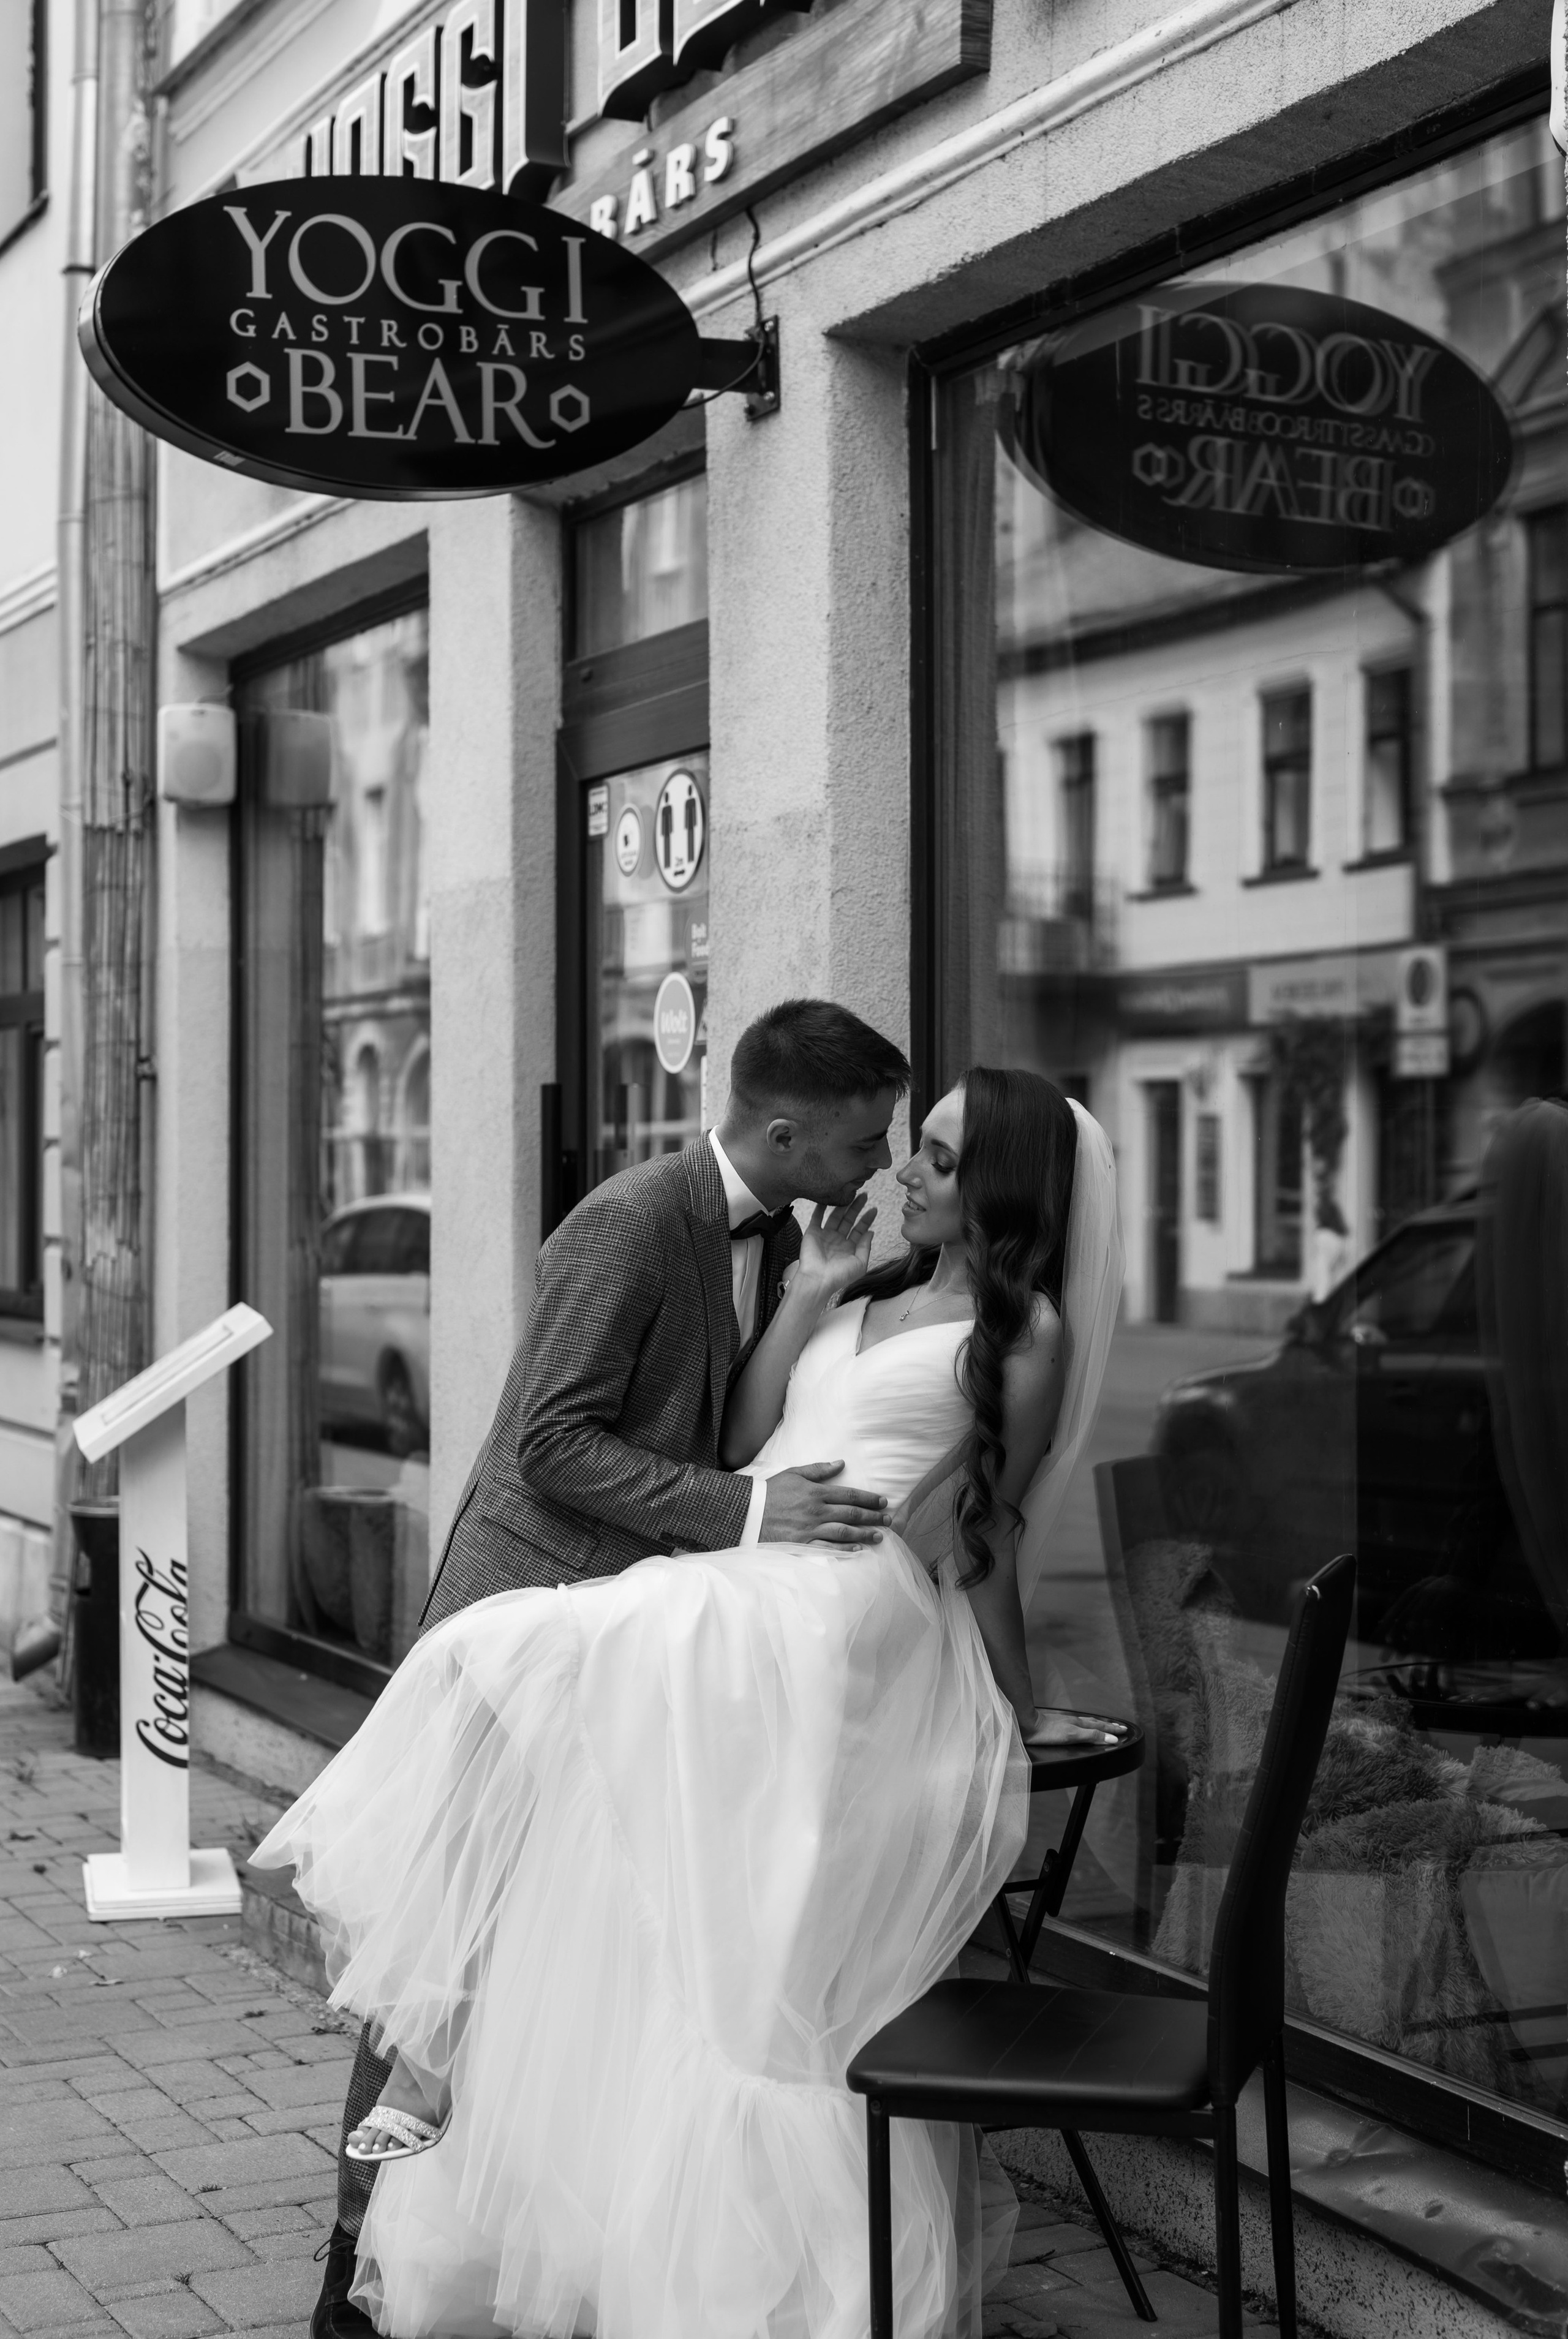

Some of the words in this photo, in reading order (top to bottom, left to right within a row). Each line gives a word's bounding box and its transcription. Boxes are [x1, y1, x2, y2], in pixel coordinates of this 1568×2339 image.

[222, 205, 589, 324] YOGGI
[229, 307, 586, 361] GASTROBĀRS
[283, 347, 556, 450] BEAR
